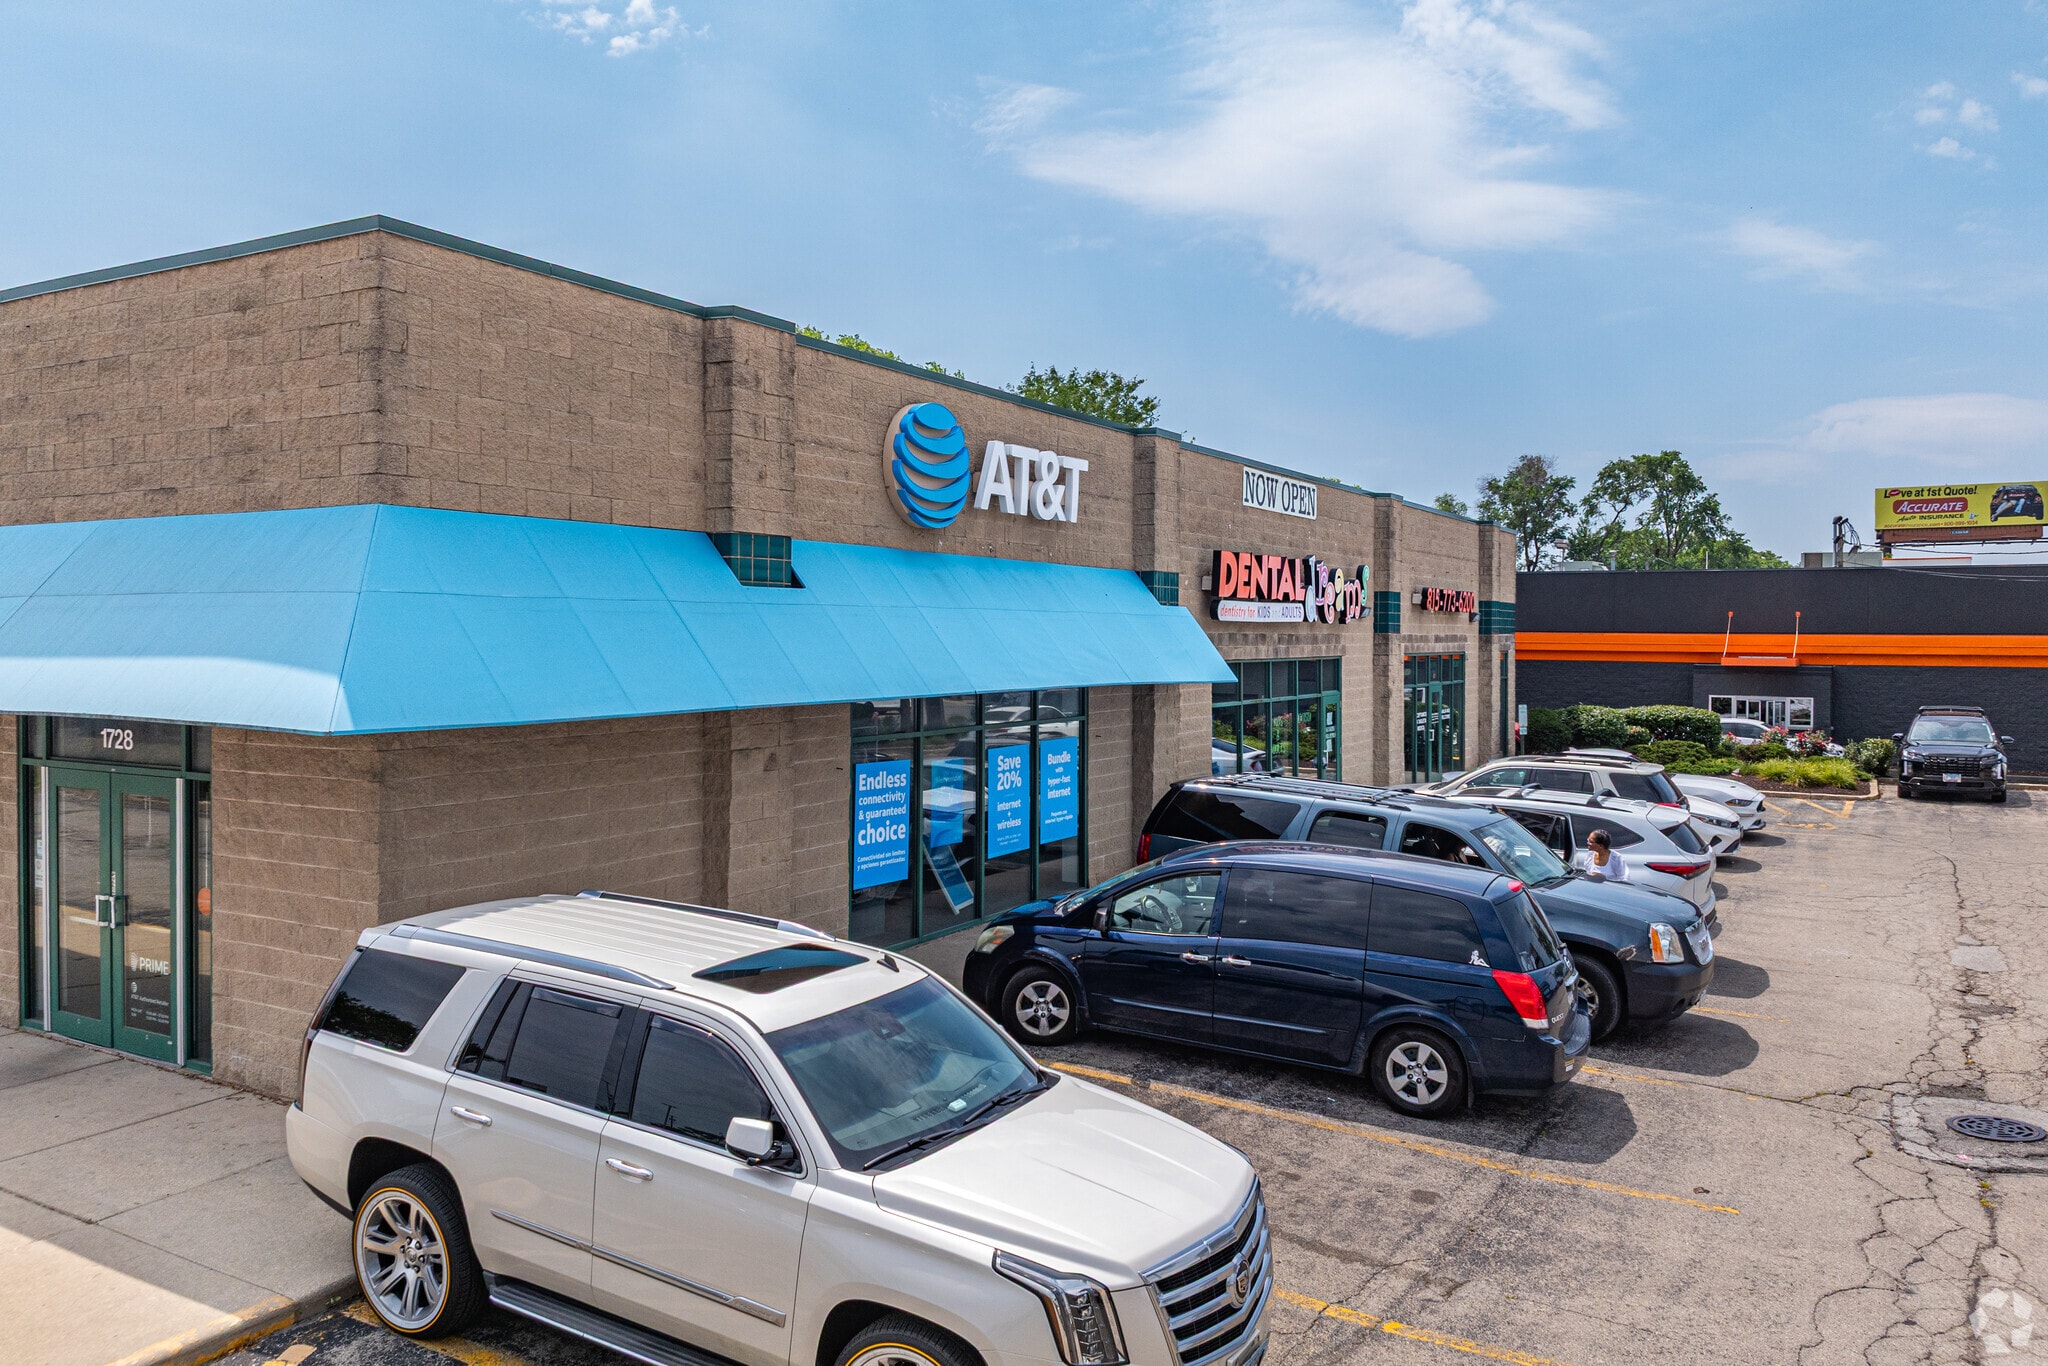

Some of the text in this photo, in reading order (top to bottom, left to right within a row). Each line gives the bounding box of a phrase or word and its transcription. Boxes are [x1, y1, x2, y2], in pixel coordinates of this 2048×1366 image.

[974, 440, 1089, 524] AT&T
[1914, 488, 1924, 497] at
[1926, 487, 1942, 497] 1st
[1943, 485, 1978, 496] Quote!
[1244, 470, 1316, 517] NOW OPEN
[1896, 501, 1965, 513] ACCURATE
[1217, 550, 1370, 624] DENTAL dreams
[1426, 587, 1475, 613] 815-773-6200
[1220, 604, 1246, 620] dentistry
[1257, 605, 1271, 619] KIDS
[1281, 606, 1302, 619] ADULTS
[100, 728, 134, 751] 1728
[997, 755, 1021, 772] Save
[1047, 750, 1071, 765] Bundle
[858, 771, 907, 791] Endless
[997, 770, 1022, 791] 20%
[858, 790, 906, 806] connectivity
[1047, 787, 1071, 799] internet
[858, 804, 907, 822] & guaranteed
[997, 799, 1021, 812] internet
[857, 820, 907, 846] choice
[997, 818, 1022, 831] wireless
[139, 956, 169, 976] PRIME
